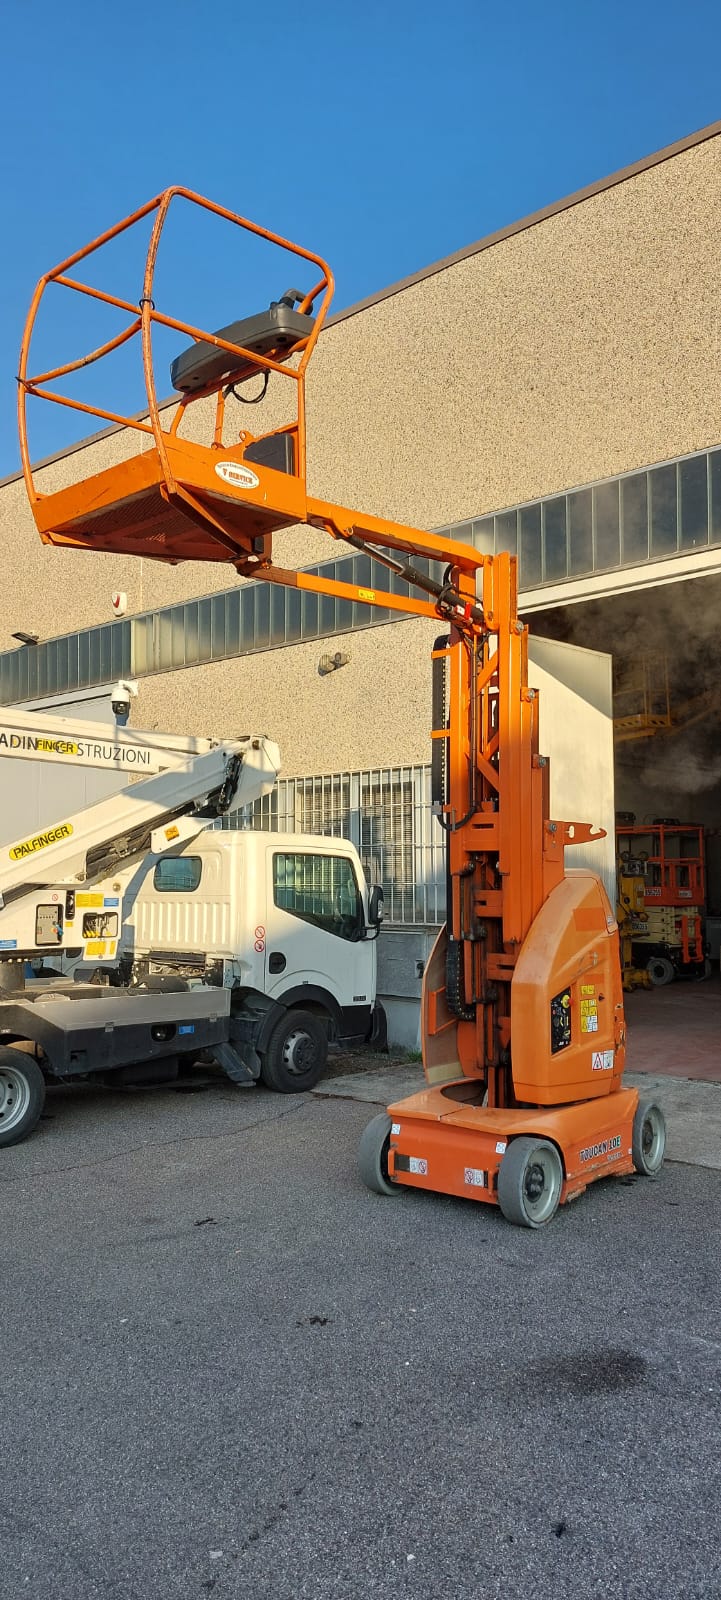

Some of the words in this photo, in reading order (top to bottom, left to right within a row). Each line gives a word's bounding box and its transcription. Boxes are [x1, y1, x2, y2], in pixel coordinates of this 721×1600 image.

[13, 826, 70, 858] PALFINGER
[580, 1140, 608, 1162] TOUCAN
[608, 1135, 622, 1151] 10E
